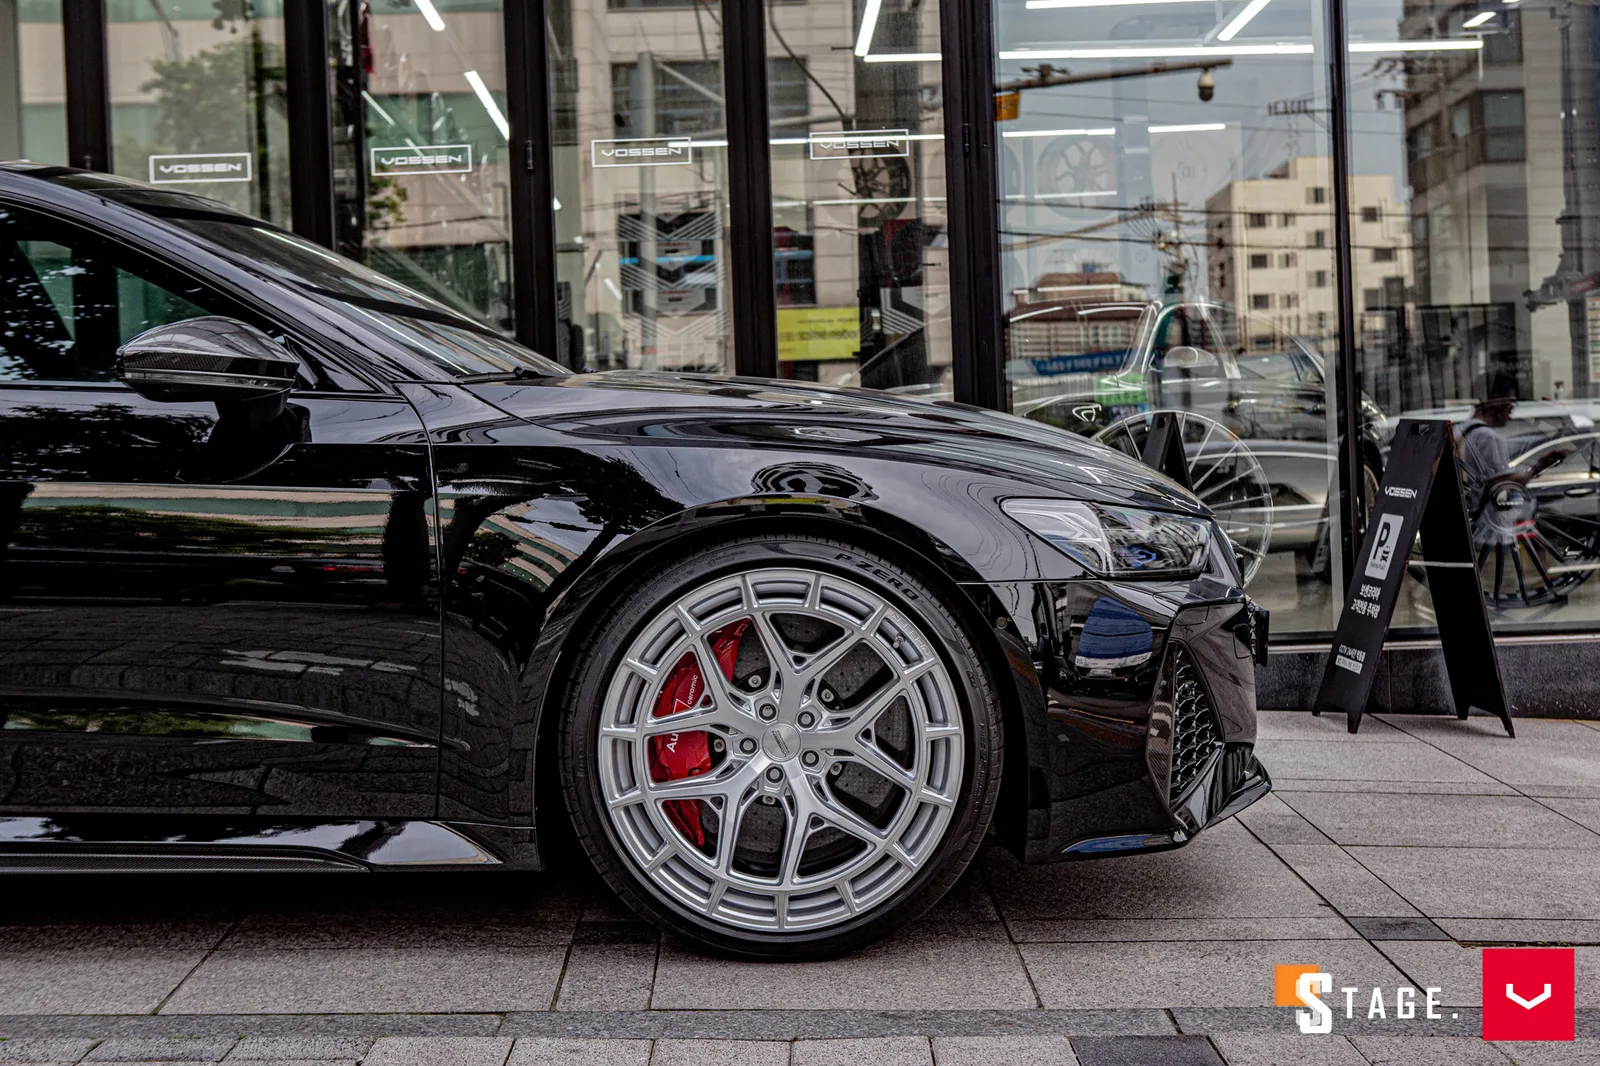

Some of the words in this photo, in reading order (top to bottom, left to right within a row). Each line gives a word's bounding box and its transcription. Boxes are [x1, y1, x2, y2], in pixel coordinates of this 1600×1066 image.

[601, 147, 682, 157] VOSSEN
[380, 154, 463, 167] VOSSEN
[159, 162, 242, 174] VOSSEN
[1384, 486, 1418, 499] VOSSEN
[834, 552, 853, 561] P
[855, 560, 919, 601] ZERO
[686, 674, 699, 705] ceramic
